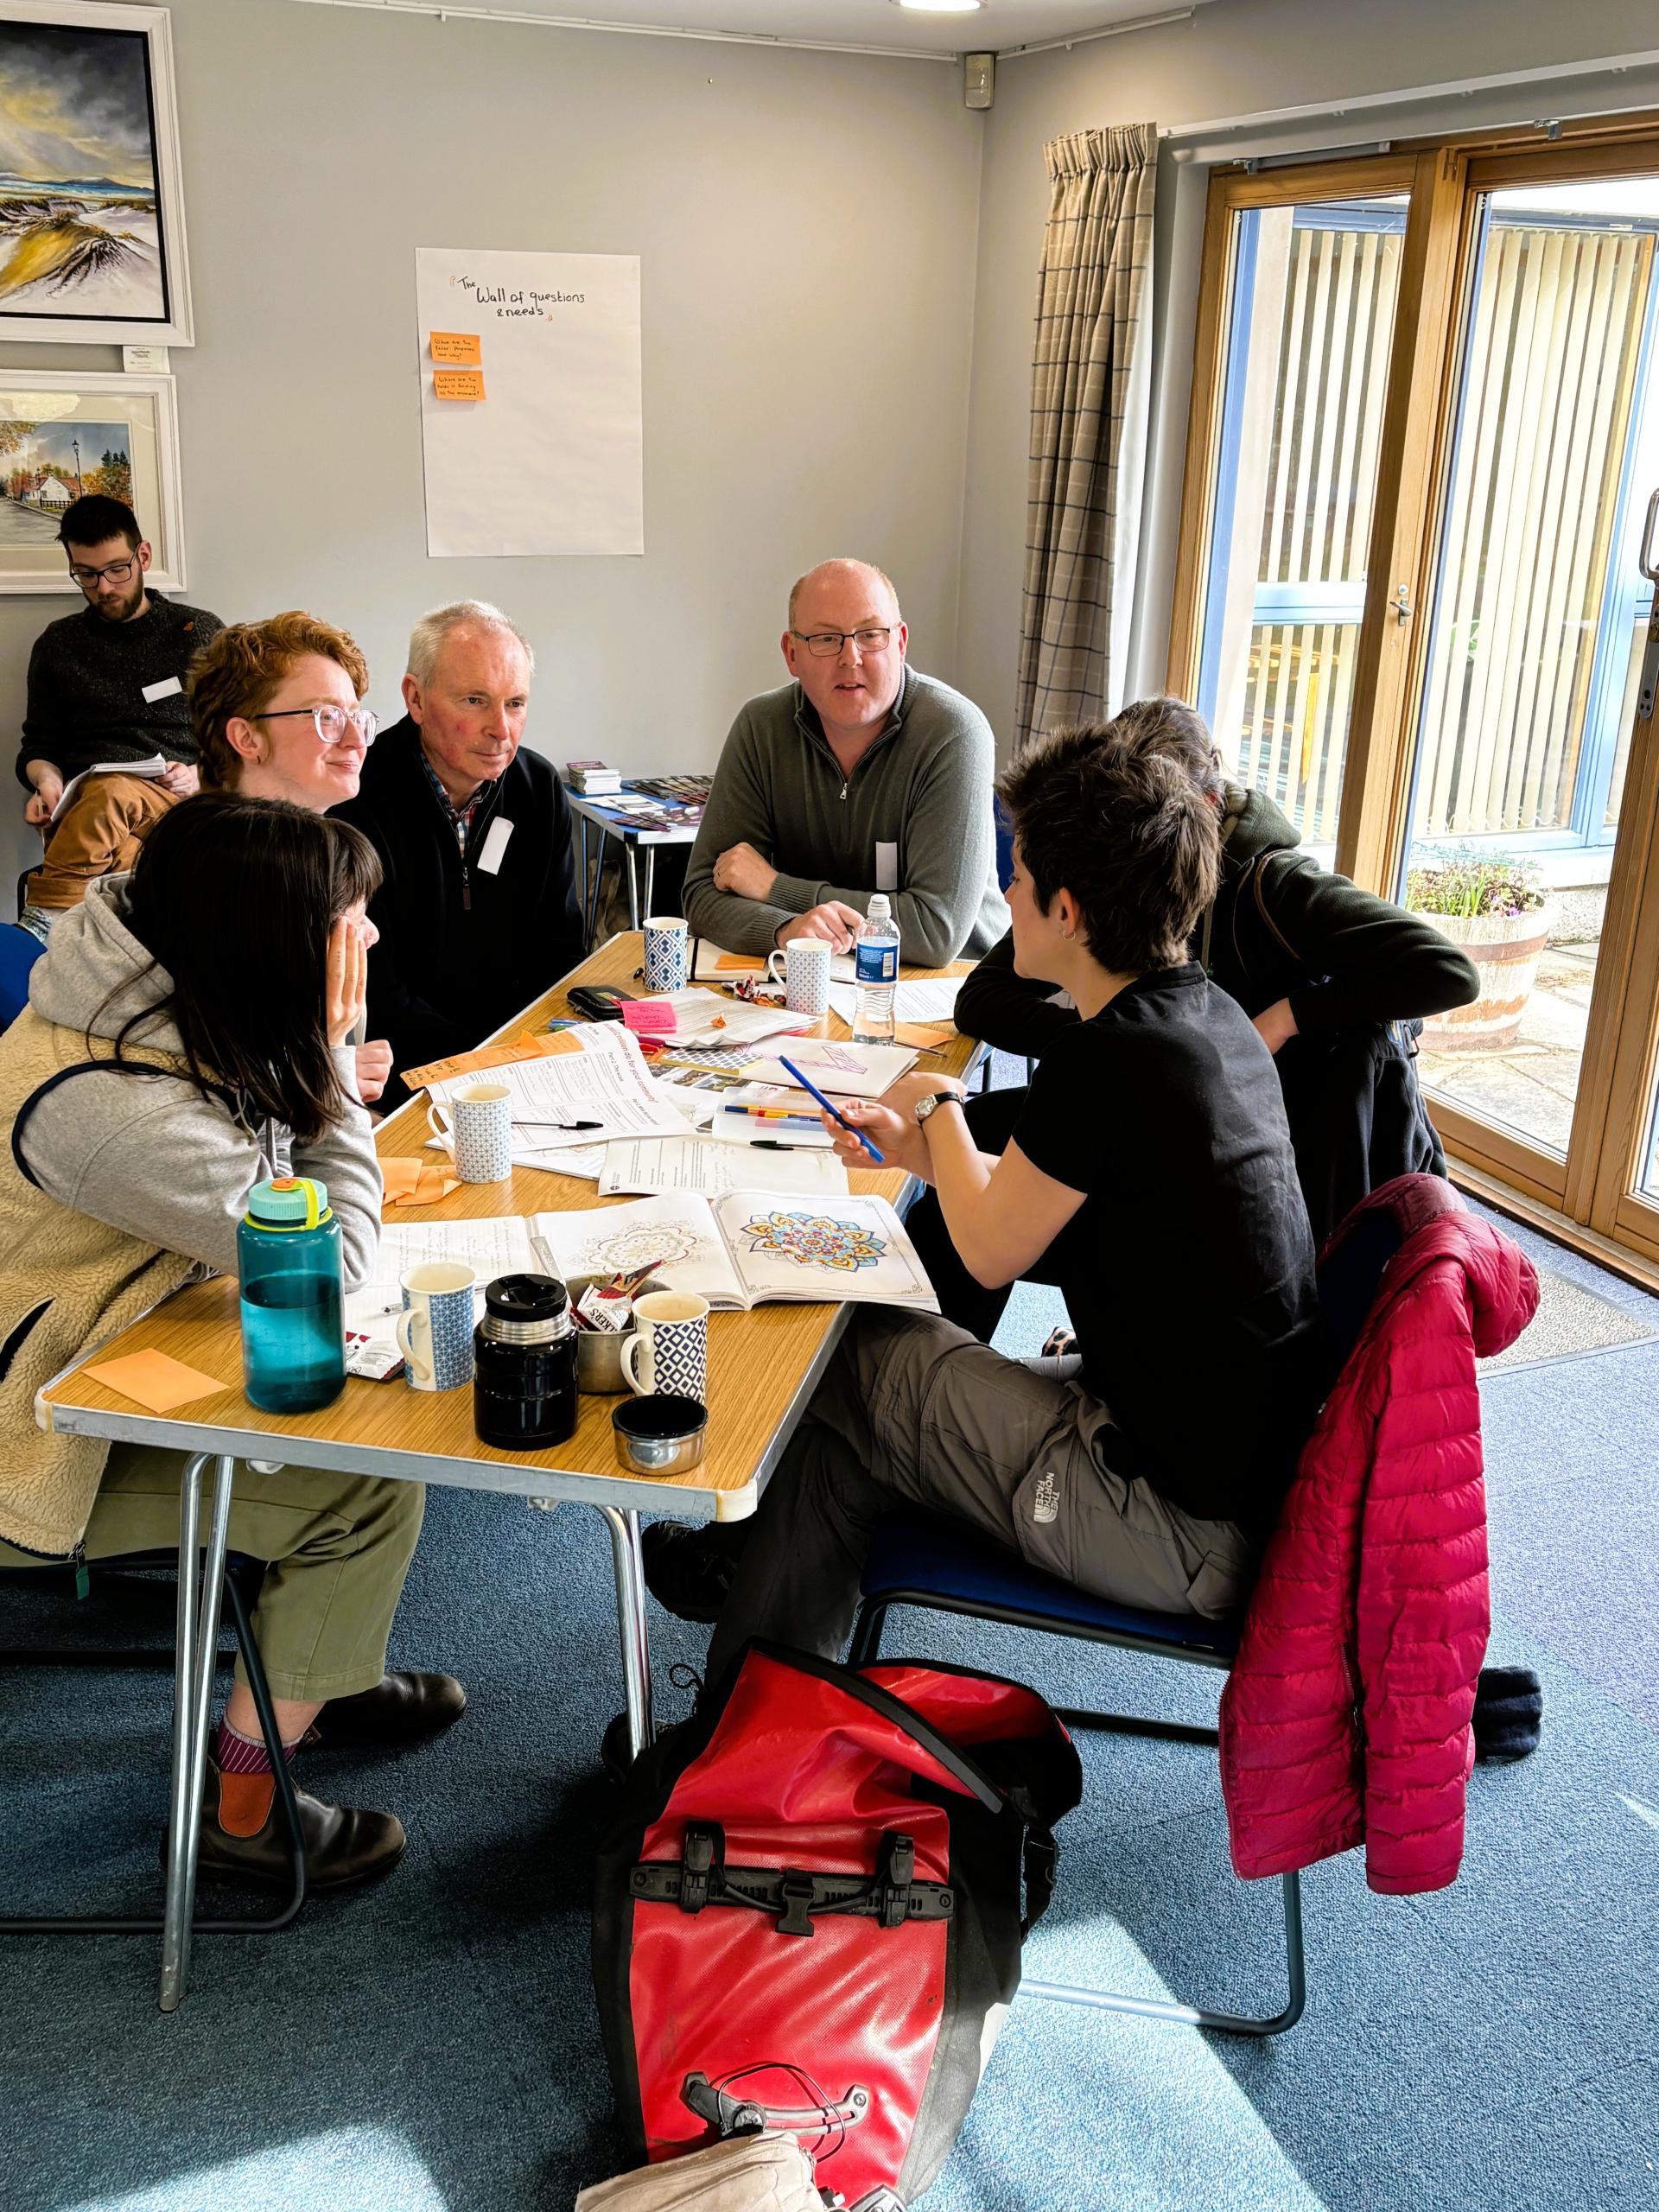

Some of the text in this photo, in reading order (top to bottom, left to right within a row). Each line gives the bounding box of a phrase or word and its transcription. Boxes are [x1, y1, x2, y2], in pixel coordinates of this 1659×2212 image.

[457, 276, 476, 289] The
[477, 287, 586, 308] Wall of questions
[589, 1307, 619, 1332] LKER'S
[1036, 1480, 1045, 1505] FACE
[1044, 1472, 1054, 1508] NORTH
[1051, 1491, 1060, 1510] THE
